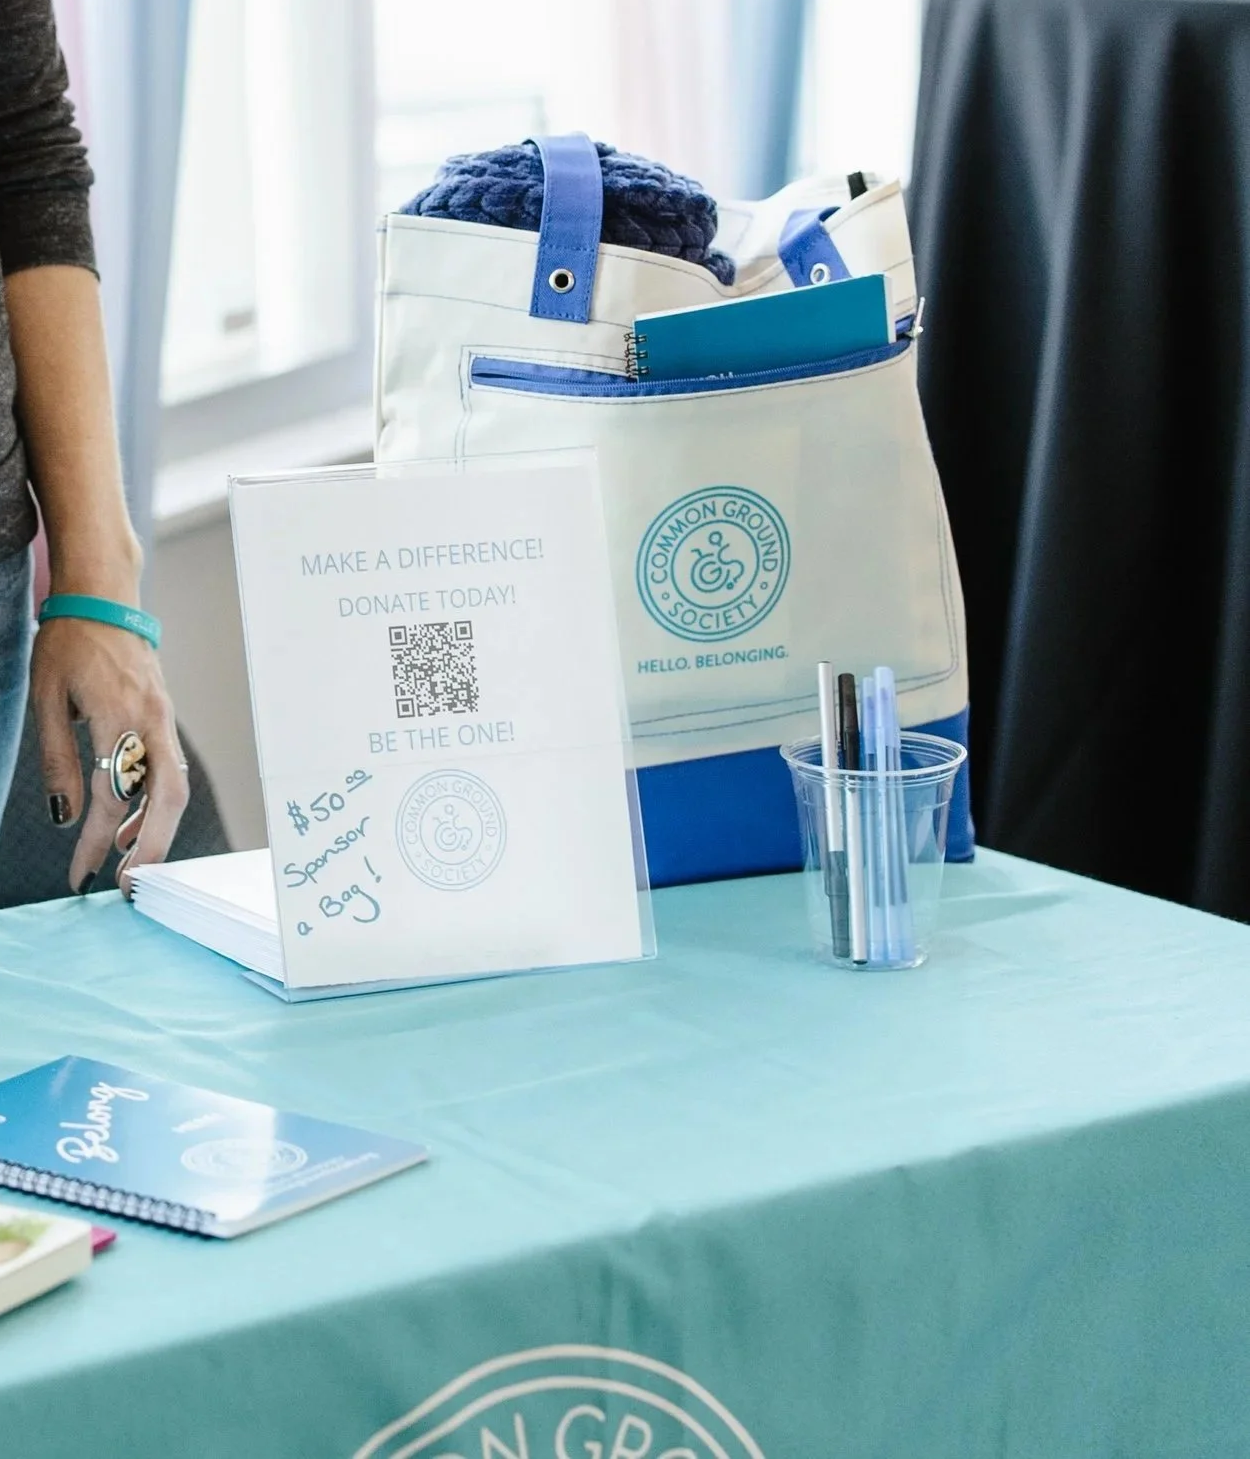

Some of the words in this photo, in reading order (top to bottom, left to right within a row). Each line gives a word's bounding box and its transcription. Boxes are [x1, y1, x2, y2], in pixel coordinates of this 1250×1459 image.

[301, 550, 369, 576] MAKE
[375, 550, 392, 571] A
[398, 538, 545, 570] DIFFERENCE!
[650, 500, 717, 584] COMMON
[723, 500, 778, 573] GROUND
[338, 591, 431, 618] DONATE
[436, 584, 517, 610] TODAY!
[668, 594, 758, 630] SOCIETY
[637, 657, 691, 674] HELLO.
[695, 645, 789, 669] BELONGING.
[368, 731, 398, 754] BE
[404, 726, 451, 751] THE
[458, 721, 515, 746] ONE!
[405, 781, 448, 844] COMMON
[452, 780, 498, 837] GROUND
[284, 816, 370, 888] Sponsor
[421, 854, 487, 881] SOCIETY
[297, 921, 313, 936] a
[55, 1081, 150, 1164] Belong
